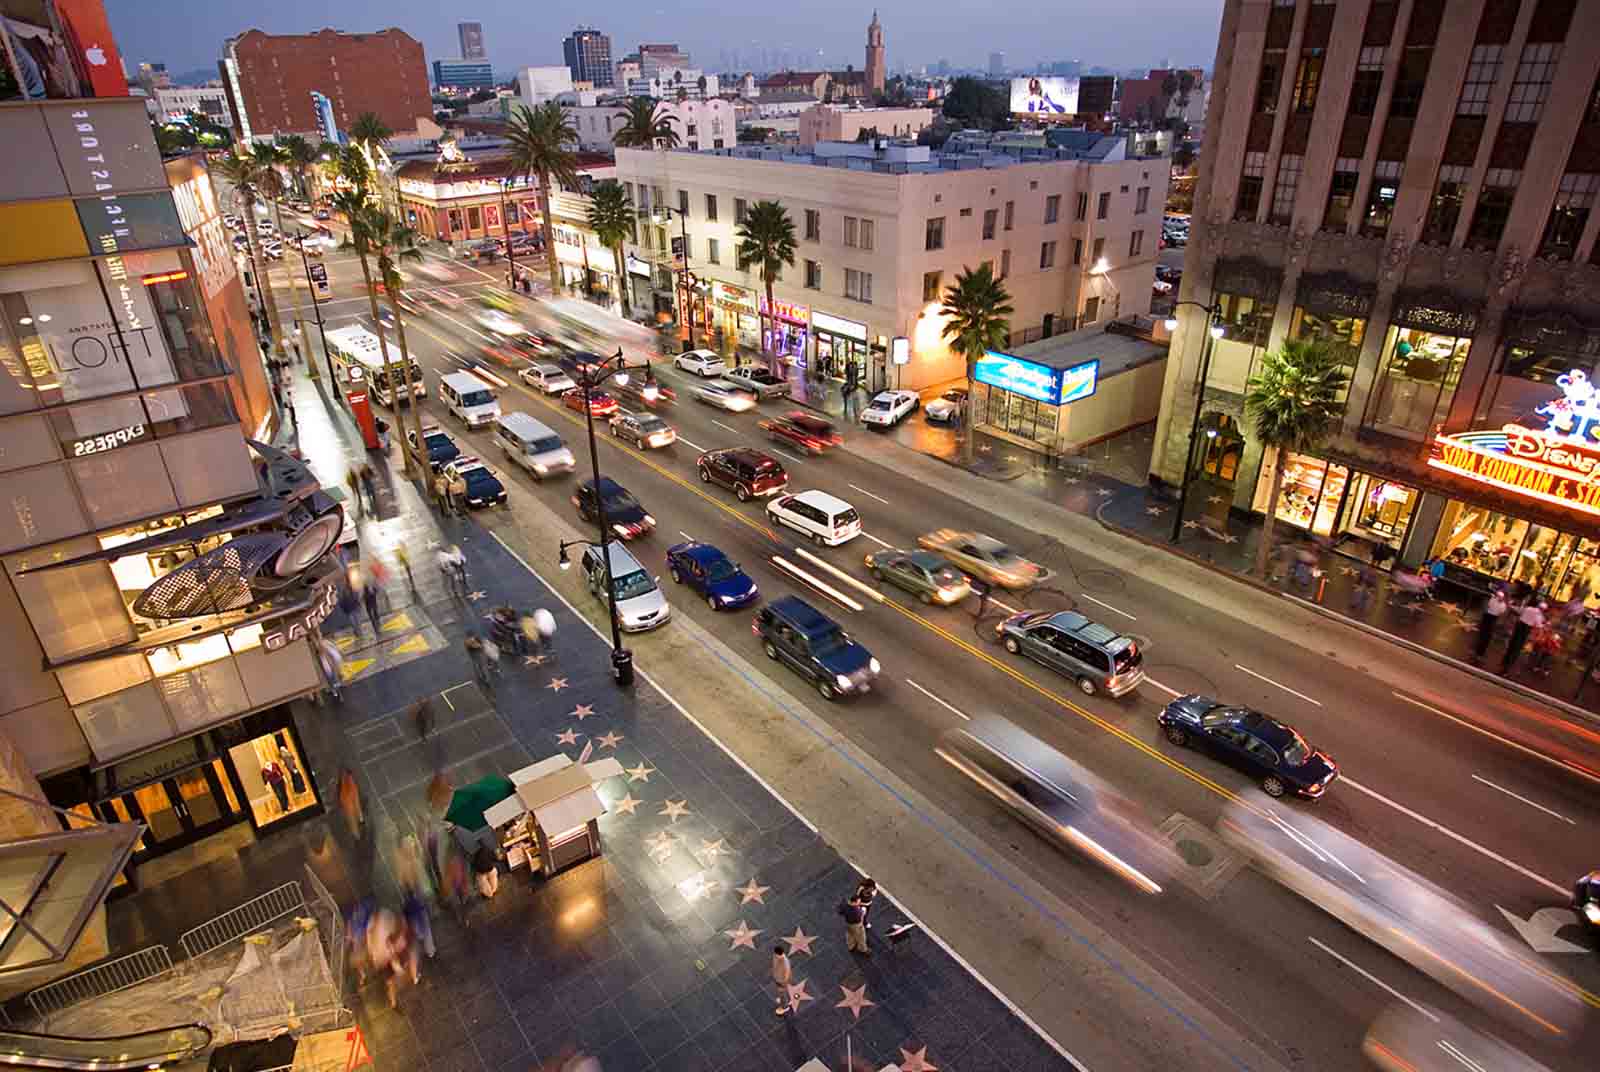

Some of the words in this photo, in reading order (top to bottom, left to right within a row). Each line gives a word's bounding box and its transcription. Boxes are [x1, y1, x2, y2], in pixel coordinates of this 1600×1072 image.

[48, 326, 153, 374] LOFT
[1439, 444, 1478, 473] SODA
[1478, 454, 1554, 496] FOUNTAIN
